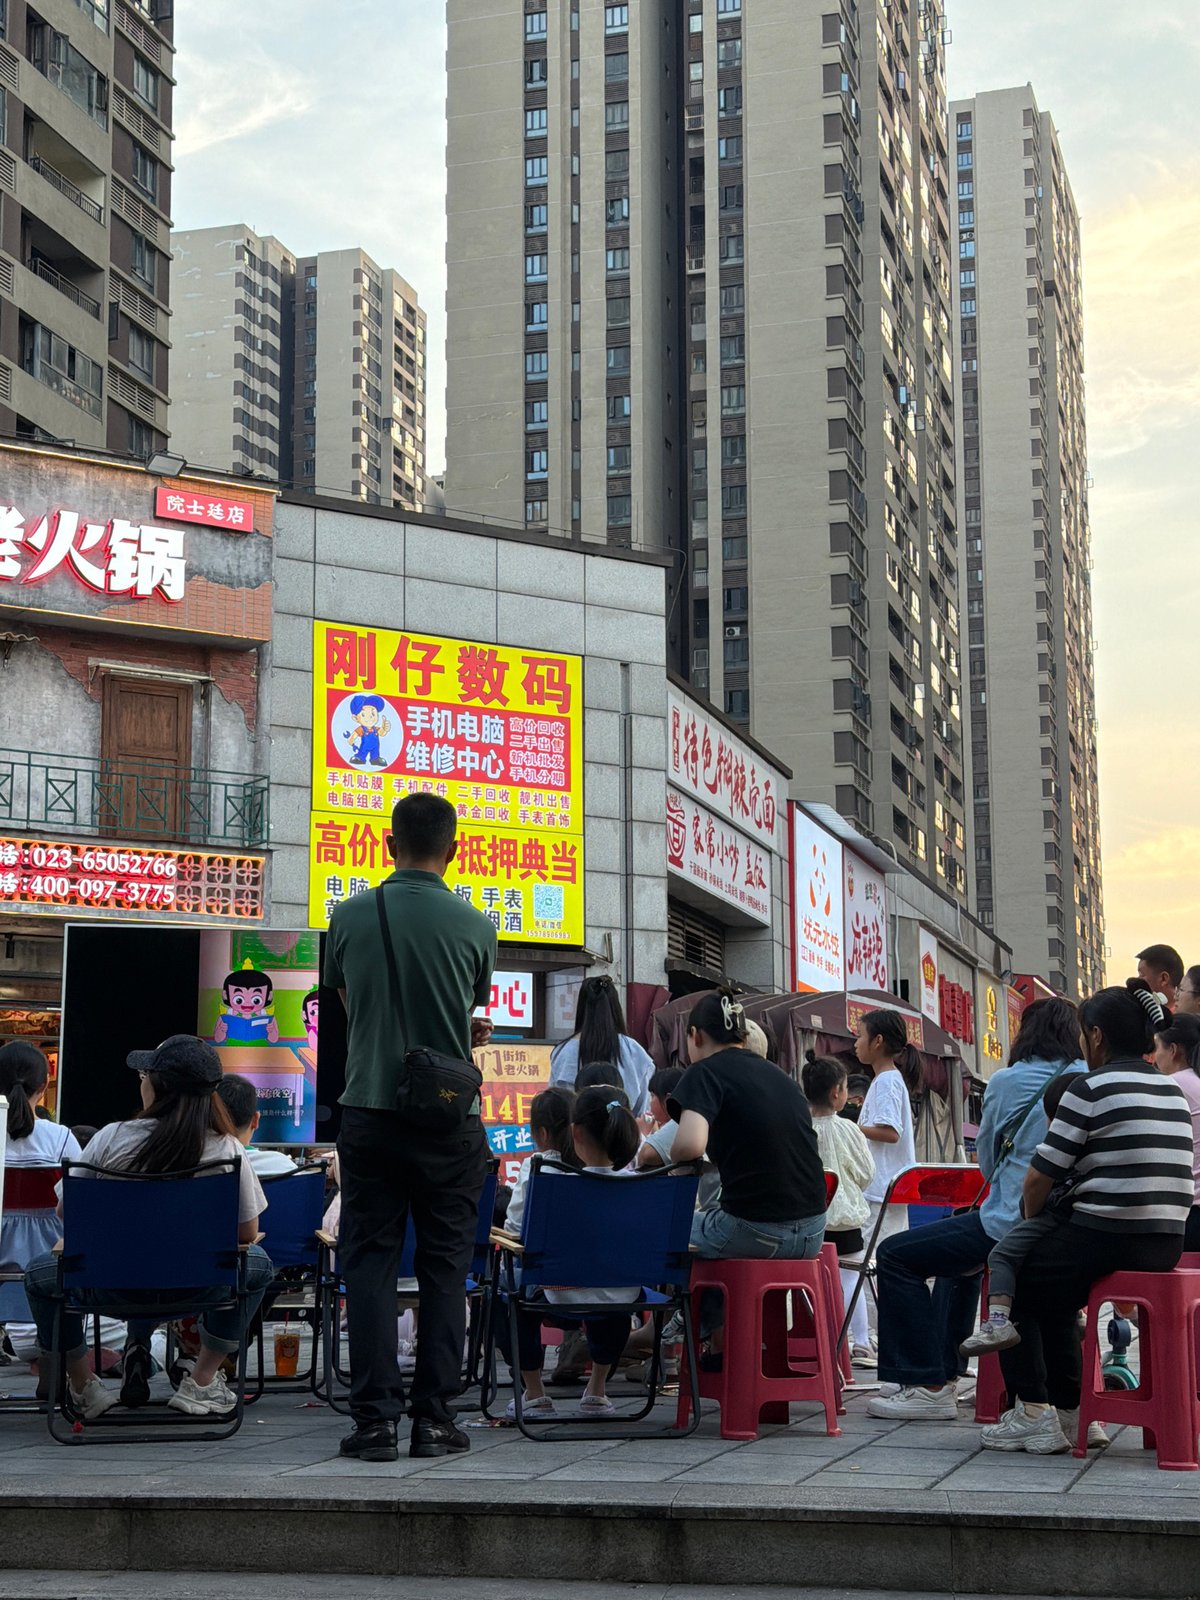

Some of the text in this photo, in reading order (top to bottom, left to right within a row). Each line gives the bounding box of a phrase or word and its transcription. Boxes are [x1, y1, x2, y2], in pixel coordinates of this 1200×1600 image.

[165, 494, 245, 525] 院士廷店
[325, 627, 572, 714] 刚仔数码
[405, 705, 505, 747] 手机电脑
[509, 717, 565, 737] 高价回收
[509, 734, 565, 753] 二手出售
[405, 739, 505, 779] 维修中心
[509, 750, 565, 770] 新机批发
[509, 767, 565, 786] 手机分期
[327, 771, 571, 810] 手机贴膜 手机配件 二手回收 靓机出售
[327, 791, 571, 828] 电脑组装 黄金回收 手表首饰
[456, 831, 577, 885] 抵押典当
[692, 807, 740, 883] 家常小炒
[326, 875, 370, 898] 电脑
[481, 886, 523, 909] 手表
[803, 913, 840, 958] 状元水饺
[848, 911, 886, 989] 麻辣烫
[484, 980, 527, 1018] 中心
[503, 1049, 526, 1062] 街坊
[504, 1064, 540, 1077] 老火锅
[483, 1092, 535, 1124] 14日
[489, 1127, 533, 1152] 开业
